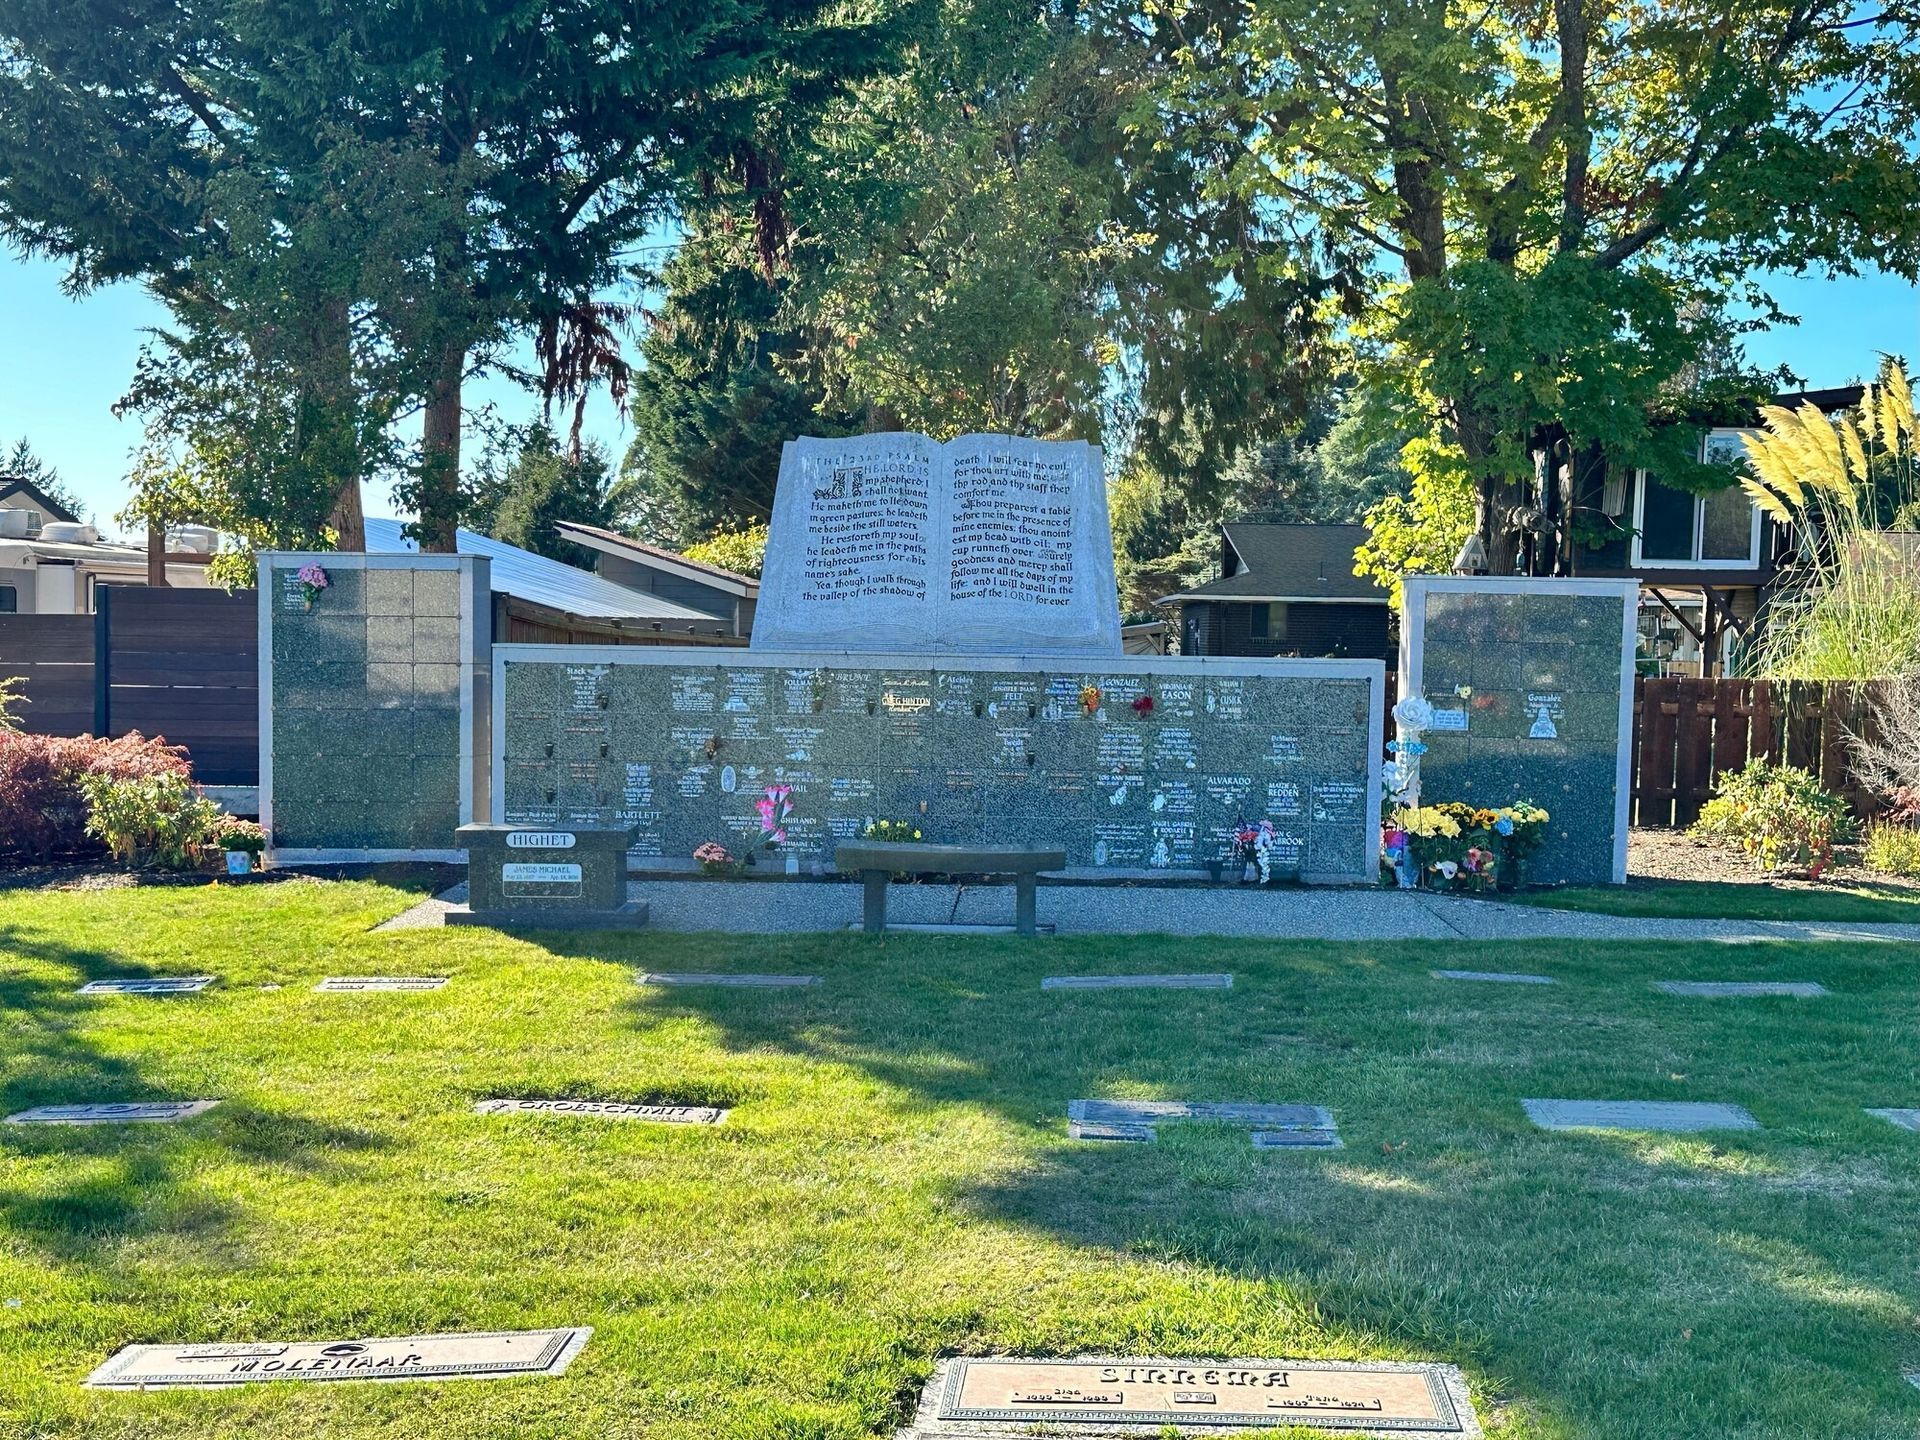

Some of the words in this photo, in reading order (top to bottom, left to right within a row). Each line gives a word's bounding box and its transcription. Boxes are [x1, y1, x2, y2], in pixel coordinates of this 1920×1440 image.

[883, 464, 914, 473] LORD
[989, 455, 991, 463] I
[994, 456, 1011, 464] will
[1013, 457, 1033, 468] fear
[1035, 461, 1047, 470] no
[954, 469, 969, 479] for
[972, 466, 992, 474] thou
[1011, 469, 1030, 479] with
[865, 486, 886, 495] shall
[889, 485, 903, 494] not
[953, 480, 968, 489] thy
[971, 477, 988, 486] rod
[990, 477, 1008, 487] and
[1009, 480, 1024, 491] thy
[1027, 483, 1048, 493] staff
[1049, 484, 1070, 495] they
[953, 488, 988, 500] comfort
[811, 502, 825, 511] He
[828, 500, 861, 510] maketh
[890, 497, 902, 505] lie
[903, 498, 928, 510] down
[994, 501, 1038, 513] preparest
[1049, 505, 1071, 515] table
[820, 514, 844, 524] green
[887, 508, 895, 516] he
[898, 508, 928, 521] leadeth
[953, 511, 980, 522] before
[982, 511, 995, 519] me
[996, 510, 1004, 518] in
[1006, 512, 1020, 521] the
[1022, 516, 1060, 527] presence
[1062, 517, 1072, 527] of
[809, 526, 824, 534] me
[824, 524, 850, 533] beside
[853, 522, 866, 531] the
[868, 519, 885, 528] still
[952, 523, 975, 533] mine
[1019, 524, 1039, 536] thou
[821, 536, 833, 544] He
[837, 530, 880, 543] restoreth
[952, 535, 966, 544] est
[968, 534, 982, 542] my
[985, 532, 1007, 541] head
[1010, 535, 1031, 545] with
[1057, 542, 1072, 550] my
[807, 547, 818, 555] he
[821, 545, 856, 555] leadeth
[859, 543, 873, 551] me
[875, 541, 884, 550] in
[886, 541, 901, 550] the
[903, 544, 926, 554] paths
[952, 547, 969, 556] cup
[971, 545, 1010, 554] runneth
[805, 559, 816, 568] of
[818, 553, 885, 568] righteousness
[888, 553, 905, 562] for
[951, 556, 995, 568] goodness
[998, 556, 1016, 565] and
[1019, 560, 1047, 572] mercy
[1050, 562, 1072, 572] shall
[835, 577, 865, 587] though
[867, 575, 870, 584] I
[873, 574, 894, 583] walk
[896, 576, 926, 589] through
[951, 567, 979, 579] follow
[996, 566, 1008, 575] all
[1010, 569, 1024, 578] the
[1026, 571, 1045, 582] days
[1047, 574, 1057, 584] of
[1059, 575, 1073, 584] my
[973, 577, 991, 586] and
[994, 577, 996, 585] I
[999, 580, 1017, 591] will
[1020, 582, 1045, 593] dwell
[1048, 585, 1056, 594] in
[1059, 586, 1074, 594] the
[802, 592, 818, 600] the
[820, 591, 847, 600] valley
[850, 589, 860, 597] of
[863, 587, 877, 595] the
[880, 586, 914, 597] shadow
[916, 591, 926, 600] of
[951, 591, 975, 601] house
[977, 588, 987, 597] of
[989, 589, 1002, 597] the
[902, 697, 930, 706] HINTON
[1162, 691, 1191, 699] EASON
[1528, 694, 1561, 702] Gonzalez
[1207, 777, 1251, 785] ALVARADO
[1268, 789, 1299, 797] REDDEN
[615, 811, 662, 819] BARTLETT
[513, 835, 569, 845] HIGHET
[230, 1354, 422, 1373] MOLENAAR
